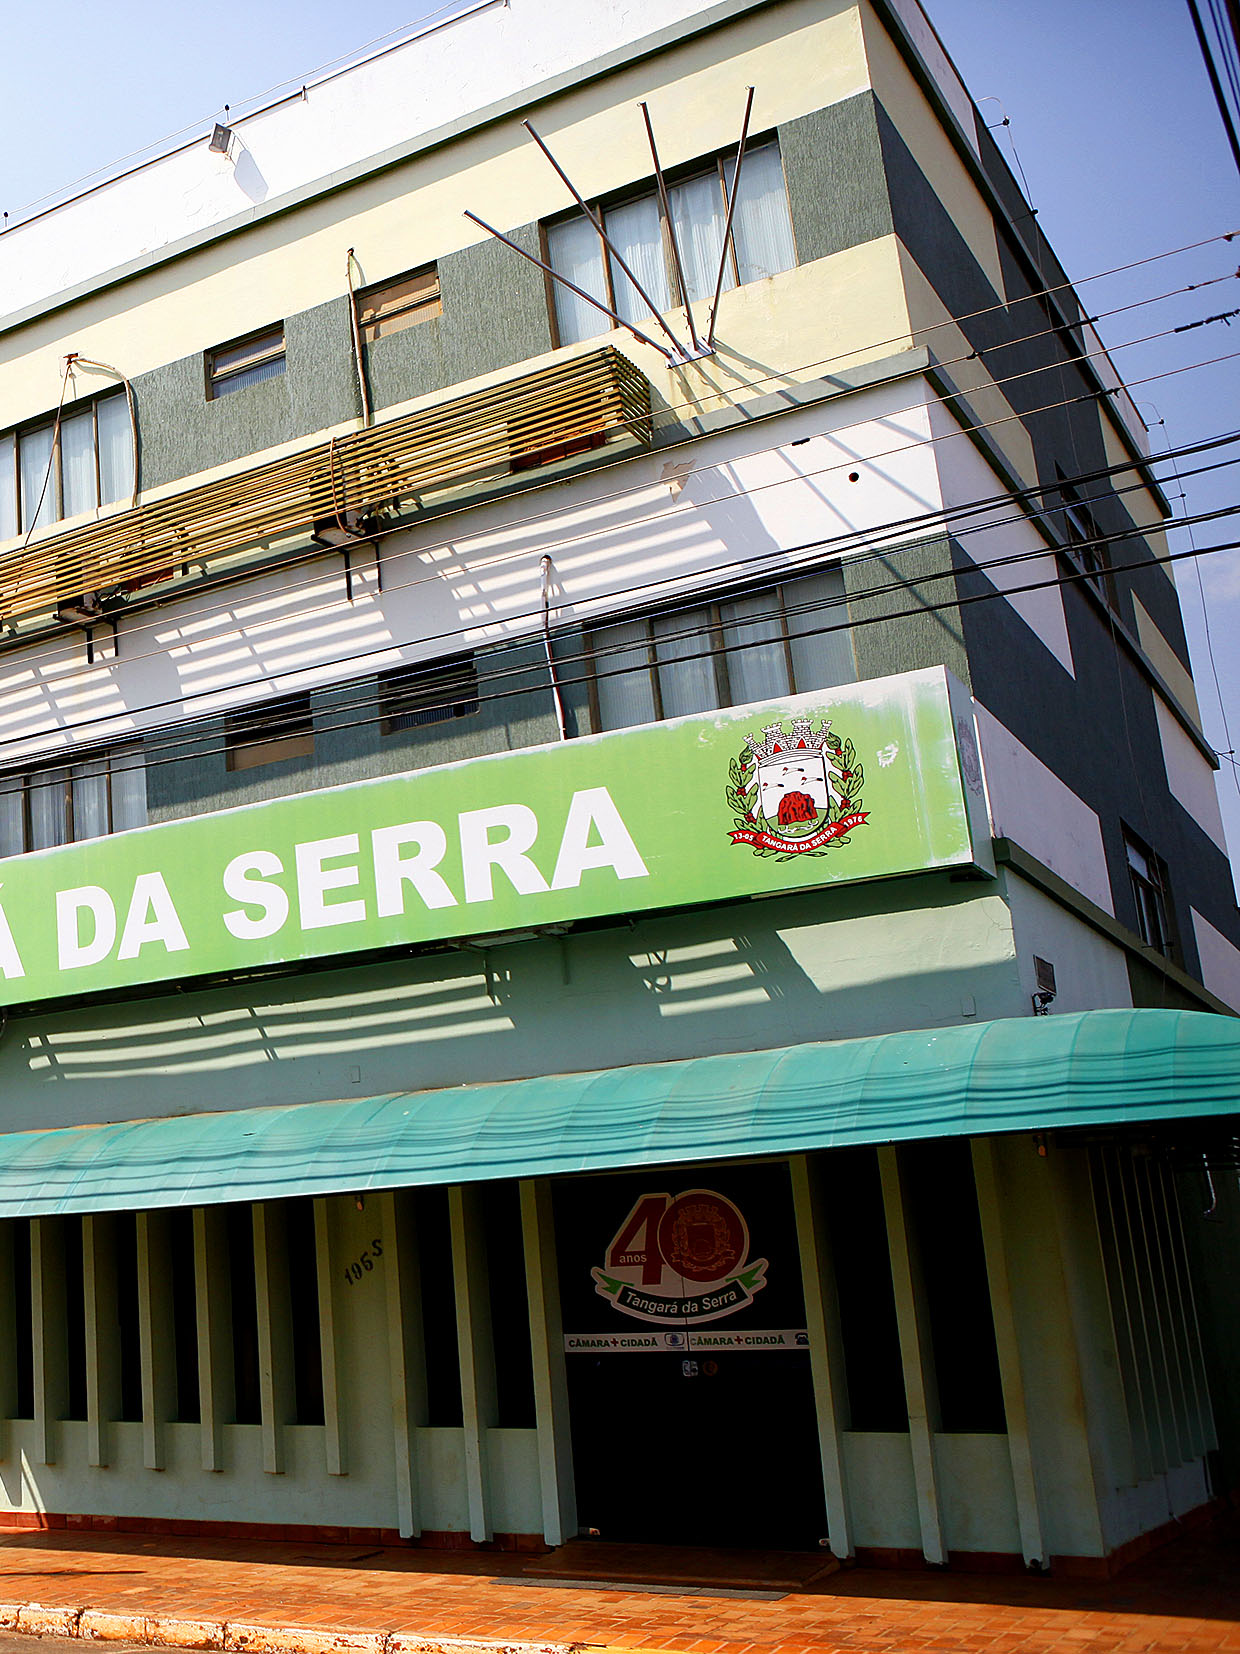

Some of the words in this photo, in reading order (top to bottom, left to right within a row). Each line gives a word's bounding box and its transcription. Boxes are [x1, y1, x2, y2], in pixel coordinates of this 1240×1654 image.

[843, 815, 863, 827] 1976
[733, 833, 754, 842] 13-05
[761, 834, 798, 851] TANGARÁ
[799, 841, 811, 851] DA
[811, 826, 837, 846] SERRA
[55, 870, 191, 971] DA
[222, 785, 650, 942] SERRA
[618, 1253, 647, 1263] anos
[626, 1291, 678, 1314] Tangará
[681, 1300, 699, 1313] da
[702, 1290, 737, 1310] Serra
